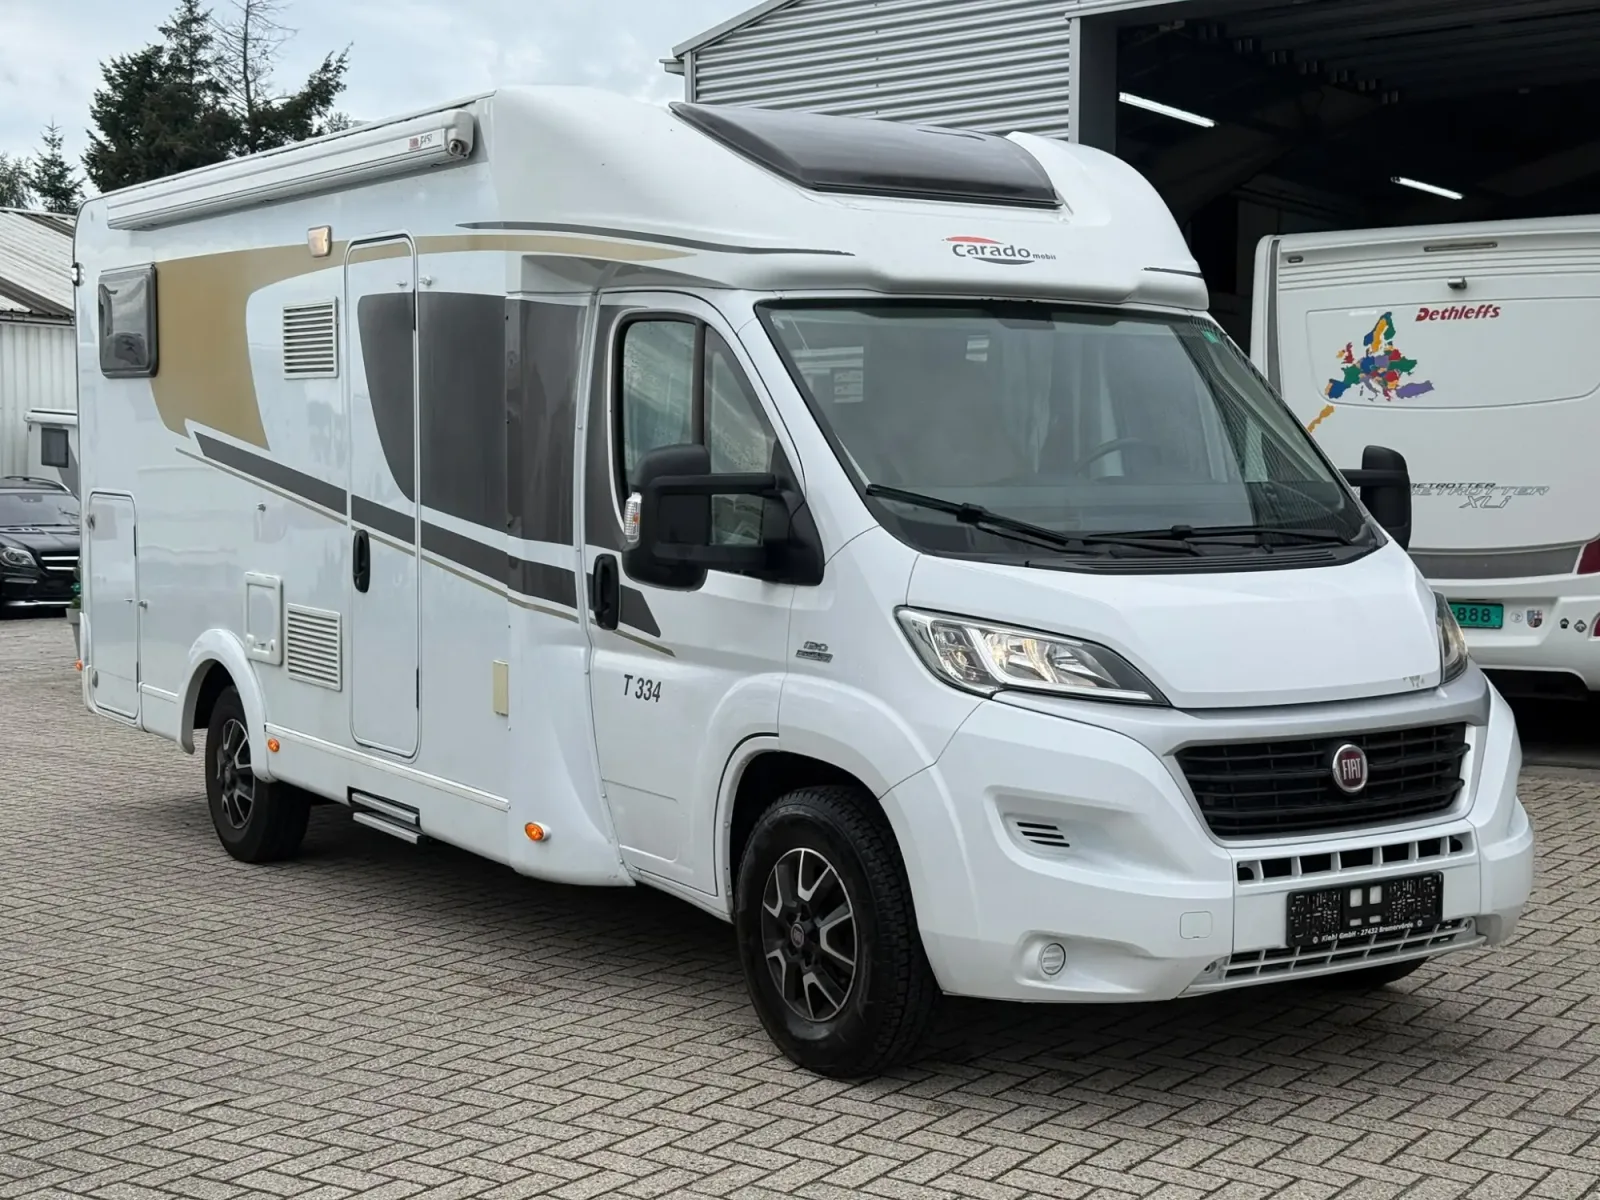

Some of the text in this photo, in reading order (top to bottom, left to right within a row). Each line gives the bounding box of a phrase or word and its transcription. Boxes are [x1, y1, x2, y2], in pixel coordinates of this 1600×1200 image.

[1415, 304, 1501, 322] Dethleffs
[624, 674, 662, 703] T 334
[1342, 757, 1361, 780] FIAT
[1339, 930, 1357, 939] GmbH
[1360, 927, 1378, 936] 27432
